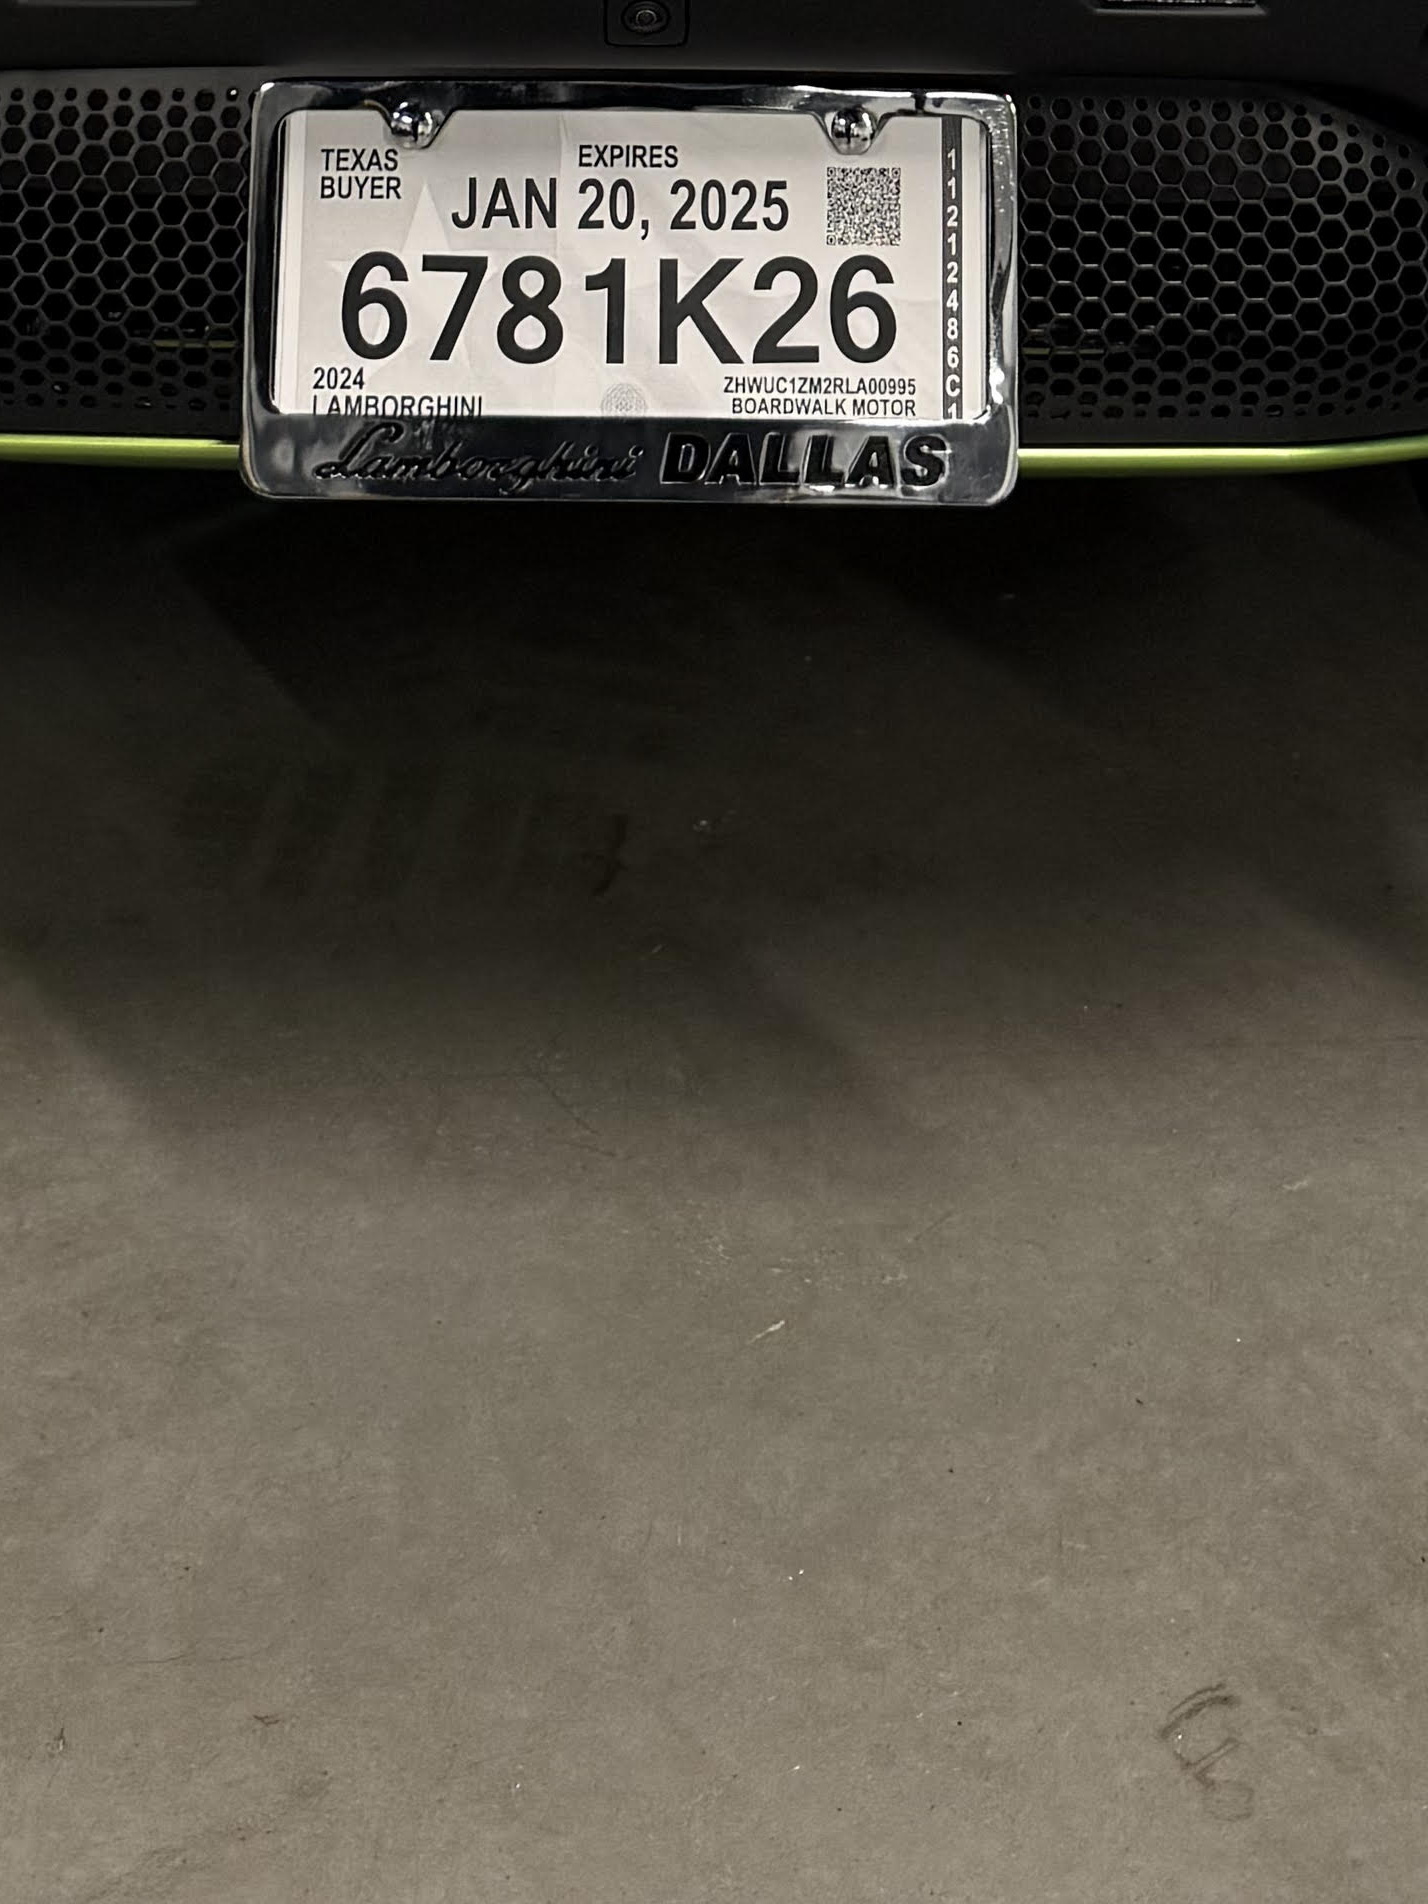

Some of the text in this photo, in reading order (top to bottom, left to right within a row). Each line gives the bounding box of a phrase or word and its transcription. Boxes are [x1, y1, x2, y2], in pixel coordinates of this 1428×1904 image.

[321, 147, 399, 172] TEXAS
[578, 144, 679, 168] EXPIRES
[320, 175, 402, 200] BUYER
[451, 177, 789, 240] JAN 20, 2025
[341, 250, 897, 365] 6781K26
[312, 366, 365, 390] 2024
[723, 376, 916, 396] ZHWUC1ZM2RLA00995
[312, 395, 482, 416] LAMBORGHINI
[731, 397, 916, 417] BOARDWALK MOTOR
[313, 421, 951, 495] Lamborghini DALLAS
